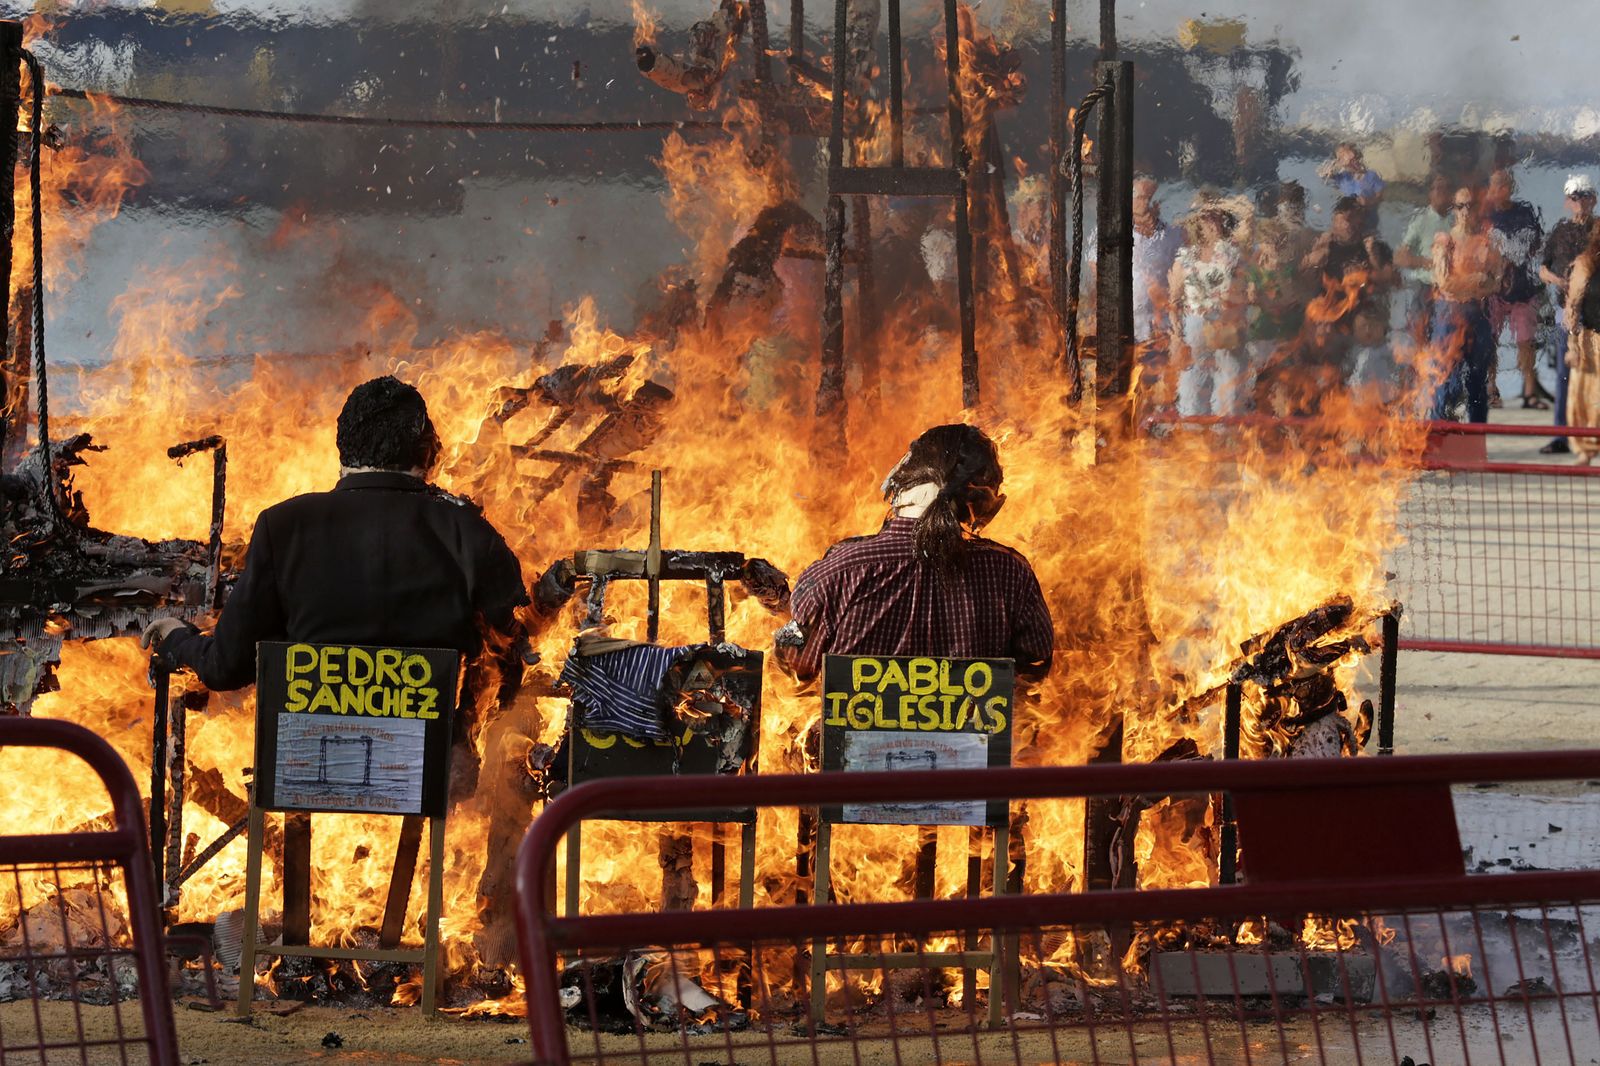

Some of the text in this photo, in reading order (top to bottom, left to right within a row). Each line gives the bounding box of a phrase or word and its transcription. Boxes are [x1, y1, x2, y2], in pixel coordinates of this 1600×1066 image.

[285, 643, 432, 688] PEDRO
[852, 657, 993, 697] PABLO
[285, 679, 440, 719] SANCHEZ
[824, 691, 1008, 734] IGLESIAS
